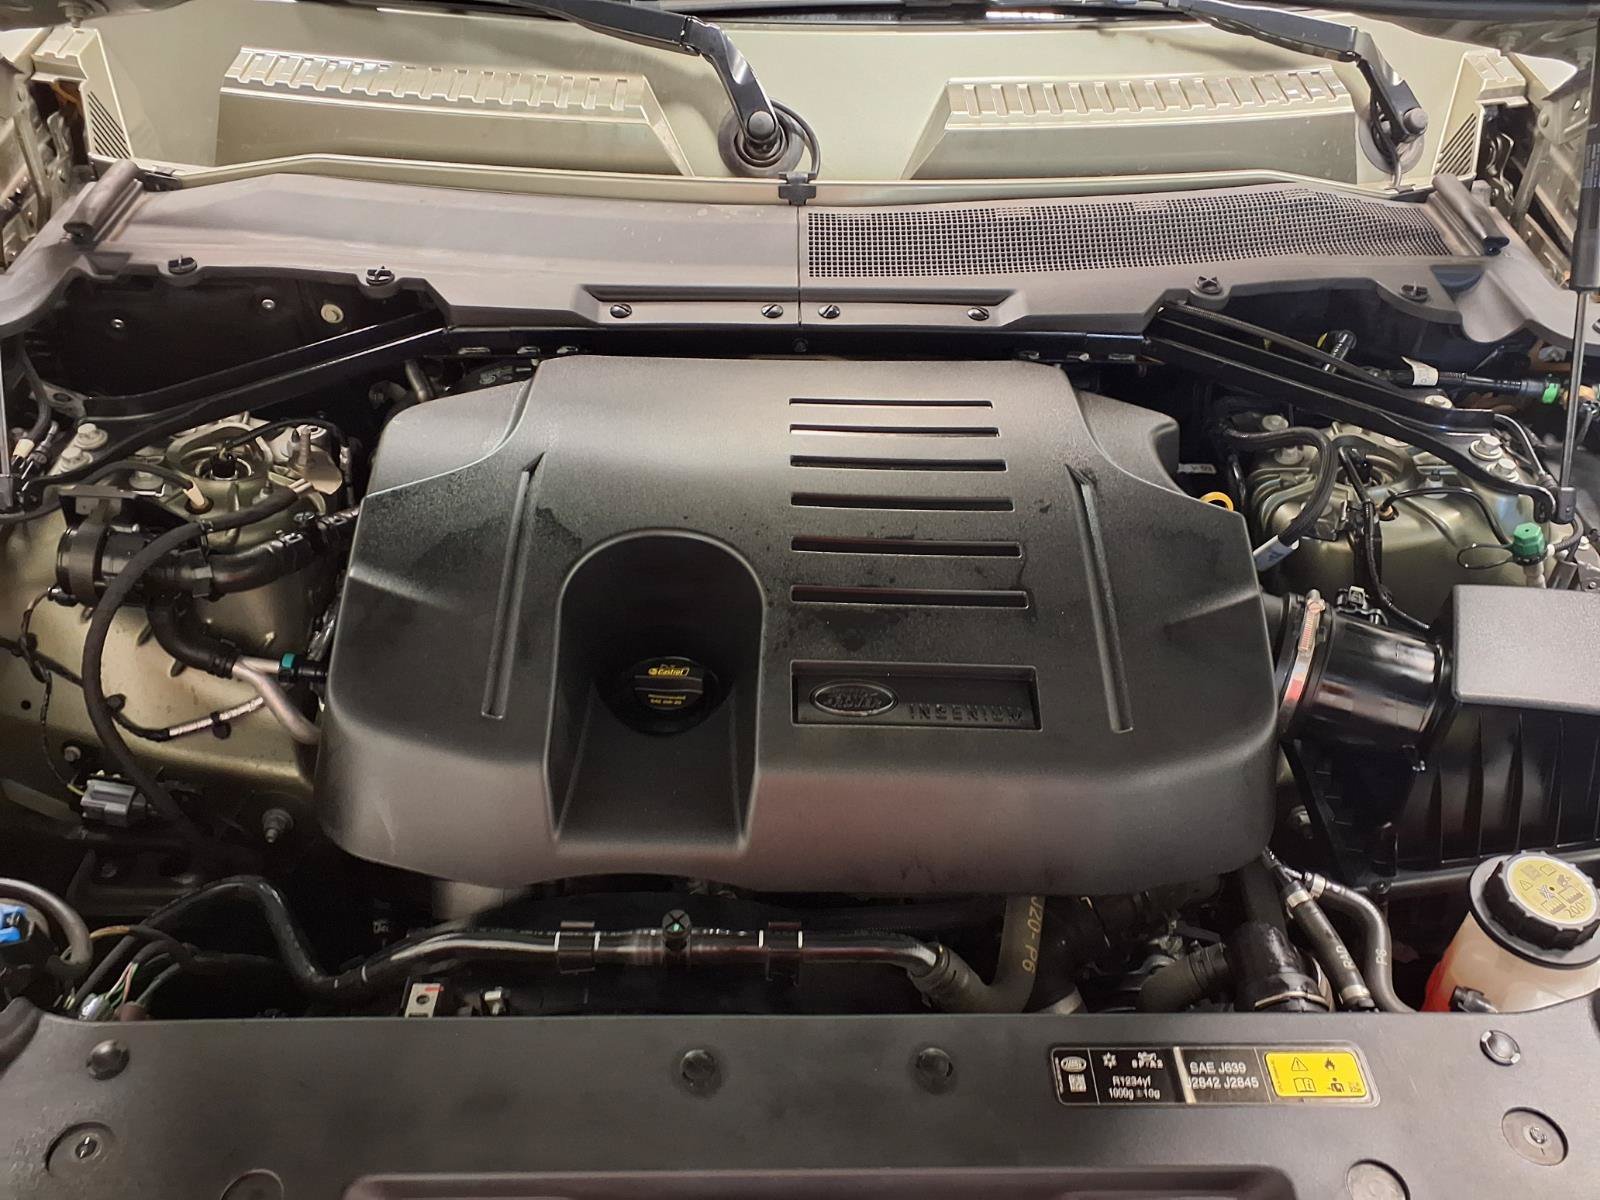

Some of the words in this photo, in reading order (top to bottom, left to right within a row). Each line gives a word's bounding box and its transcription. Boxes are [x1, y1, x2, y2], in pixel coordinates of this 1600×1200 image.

[909, 703, 1023, 722] INGENIUM
[1190, 1061, 1216, 1075] SAE
[1218, 1061, 1247, 1075] J639
[1187, 1076, 1222, 1090] J2842
[1224, 1076, 1260, 1089] J2845
[1109, 1087, 1134, 1100] 1000g
